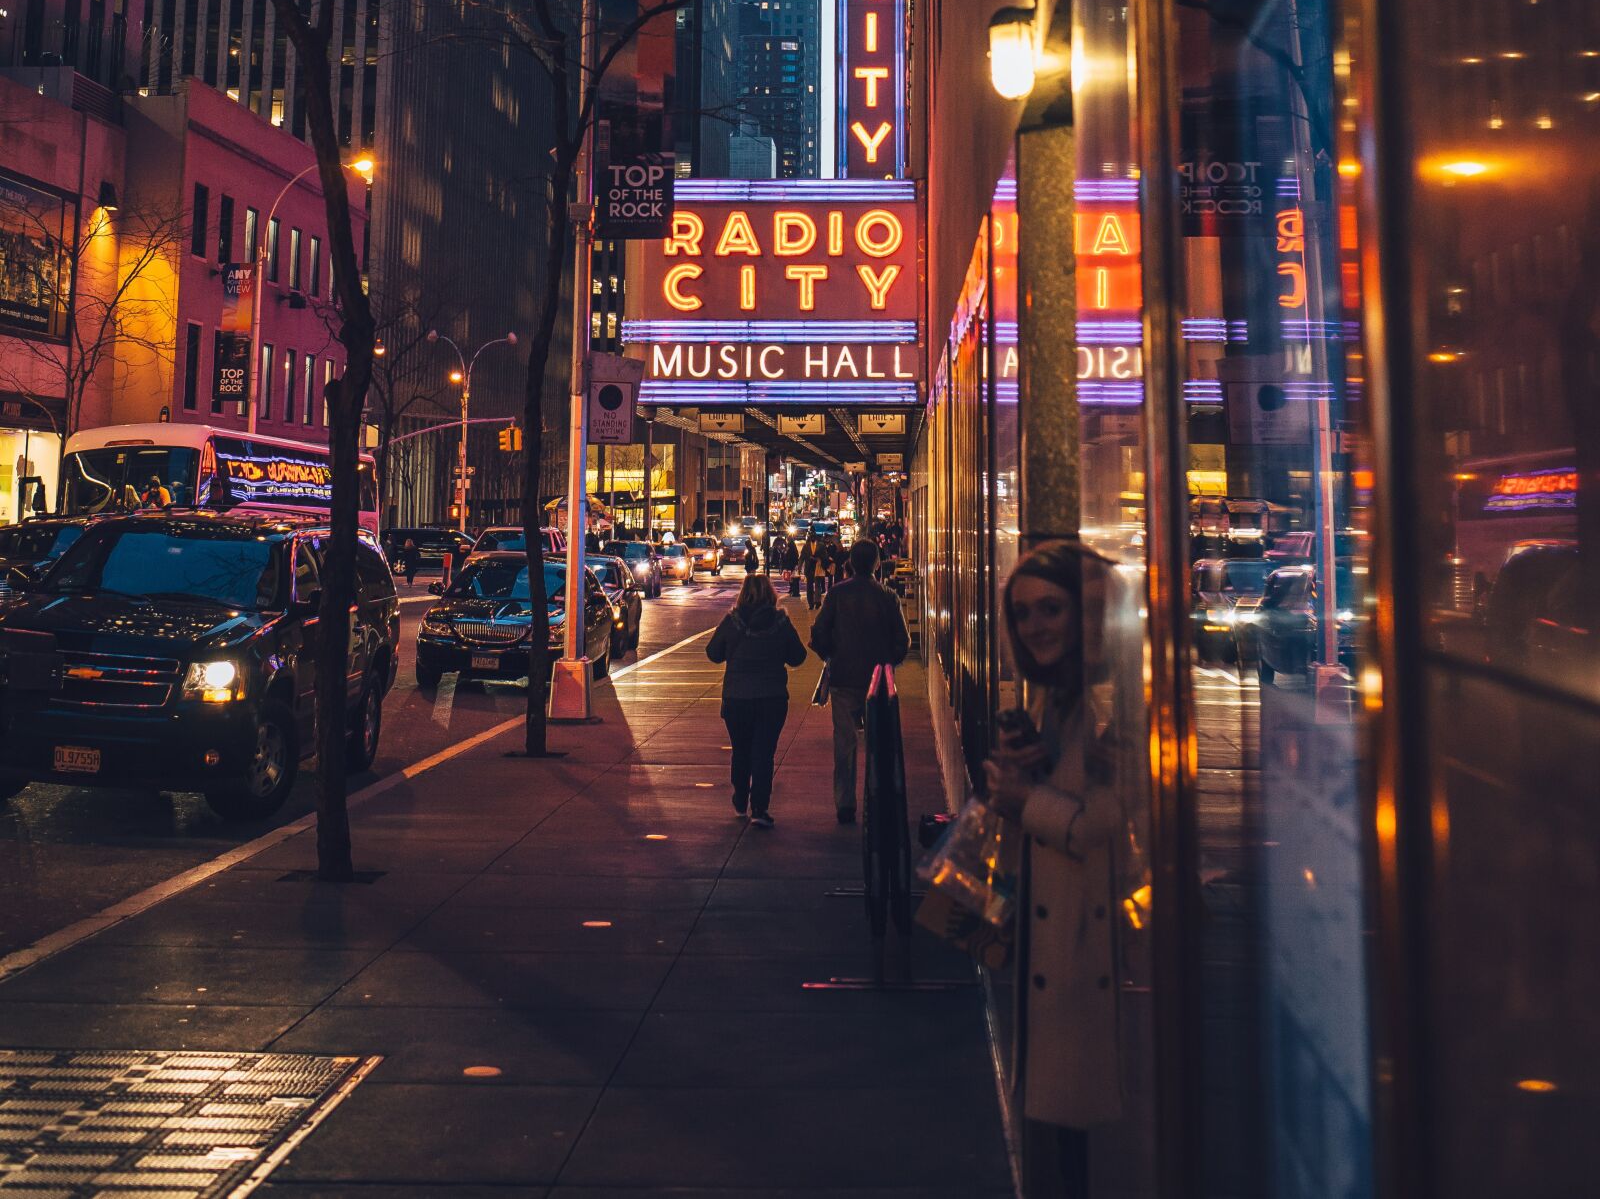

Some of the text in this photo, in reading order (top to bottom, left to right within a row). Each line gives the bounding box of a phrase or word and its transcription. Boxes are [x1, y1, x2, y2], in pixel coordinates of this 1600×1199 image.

[608, 165, 665, 187] TOP
[609, 188, 664, 201] OF THE
[609, 202, 664, 218] ROCK
[663, 209, 904, 258] RADIO
[227, 269, 252, 280] ANY
[227, 285, 251, 294] VIEW
[663, 263, 903, 312] CITY
[652, 345, 914, 379] MUSIC HALL
[220, 368, 244, 379] TOP
[219, 384, 243, 392] ROCK
[603, 411, 617, 420] NO
[592, 419, 628, 428] STANDING
[595, 427, 625, 435] ANYTIME
